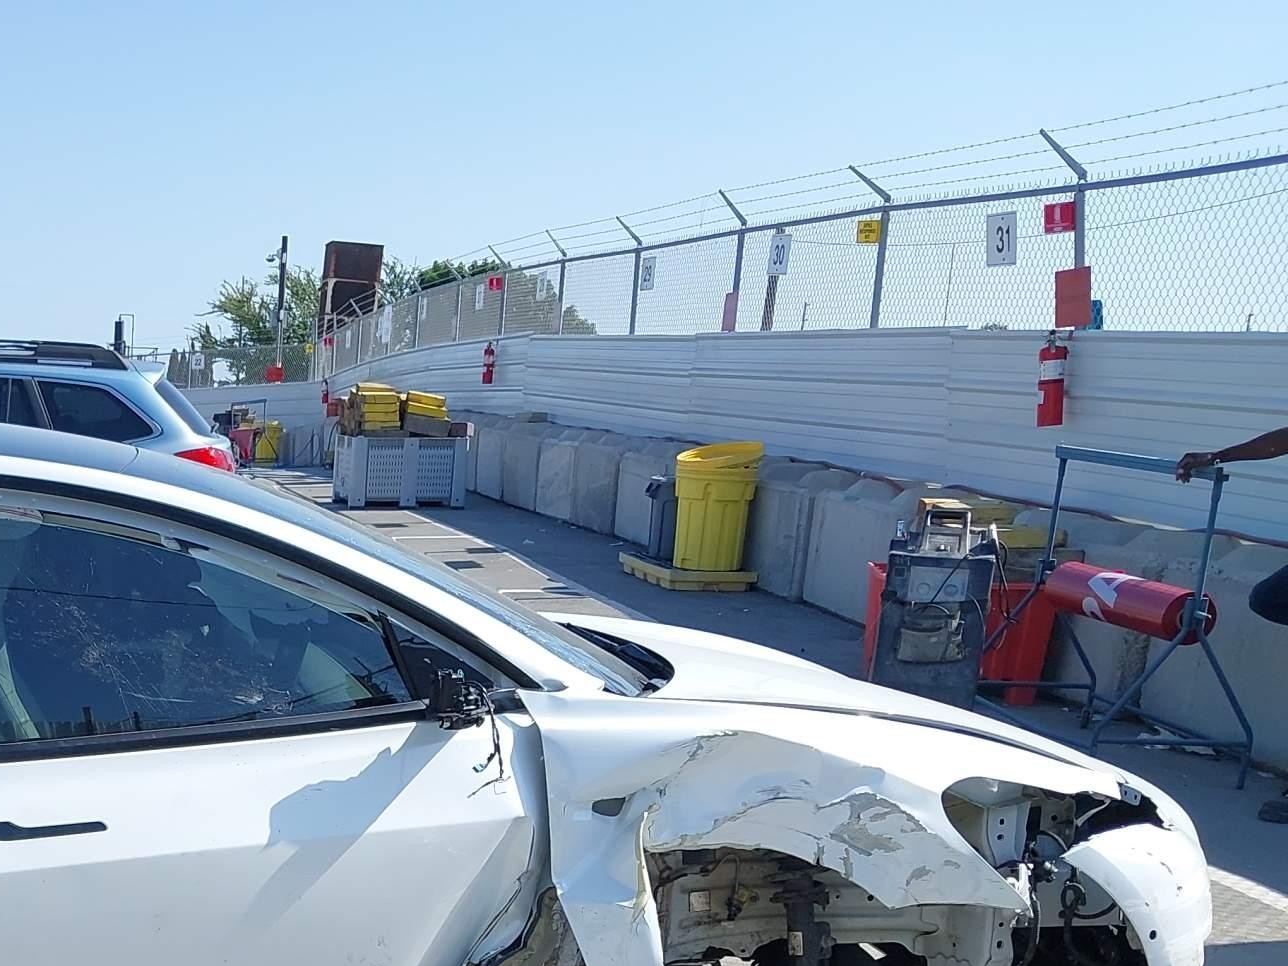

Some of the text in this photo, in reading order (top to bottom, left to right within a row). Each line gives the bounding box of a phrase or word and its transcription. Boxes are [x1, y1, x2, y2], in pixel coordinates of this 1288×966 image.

[996, 225, 1010, 253] 31
[773, 244, 785, 265] 30
[643, 265, 652, 282] 29
[195, 358, 202, 367] 22
